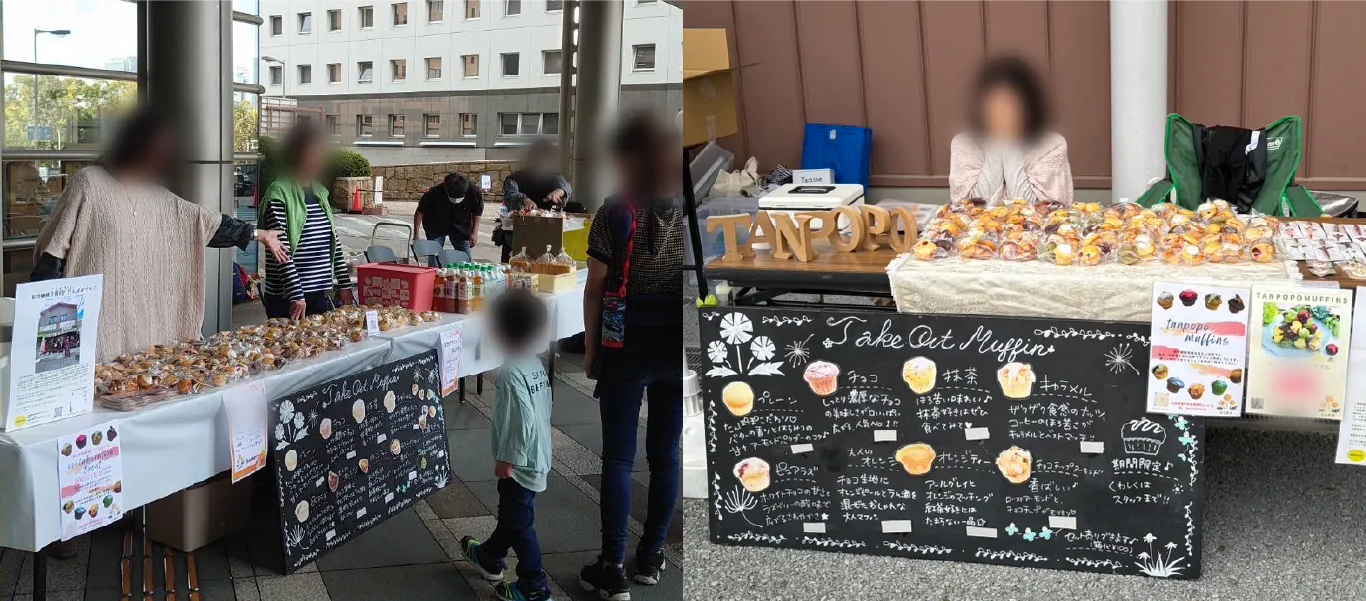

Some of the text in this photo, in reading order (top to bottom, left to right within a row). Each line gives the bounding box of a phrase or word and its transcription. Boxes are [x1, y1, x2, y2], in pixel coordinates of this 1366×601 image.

[707, 204, 918, 263] TANPOPO
[1166, 318, 1210, 333] tanpopo
[826, 316, 1049, 363] Take Out Muffin
[1184, 334, 1230, 347] muffins
[848, 370, 878, 383] チョコ
[942, 367, 978, 385] 抹茶
[1040, 374, 1092, 396] キャラメル
[758, 391, 797, 404] プレーン
[916, 406, 988, 420] 抹茶好きはぜひ
[1111, 458, 1161, 472] 期間限定
[837, 473, 889, 485] チョコ生地に
[925, 477, 976, 489] アールグレイと
[1109, 481, 1151, 492] くわしくは
